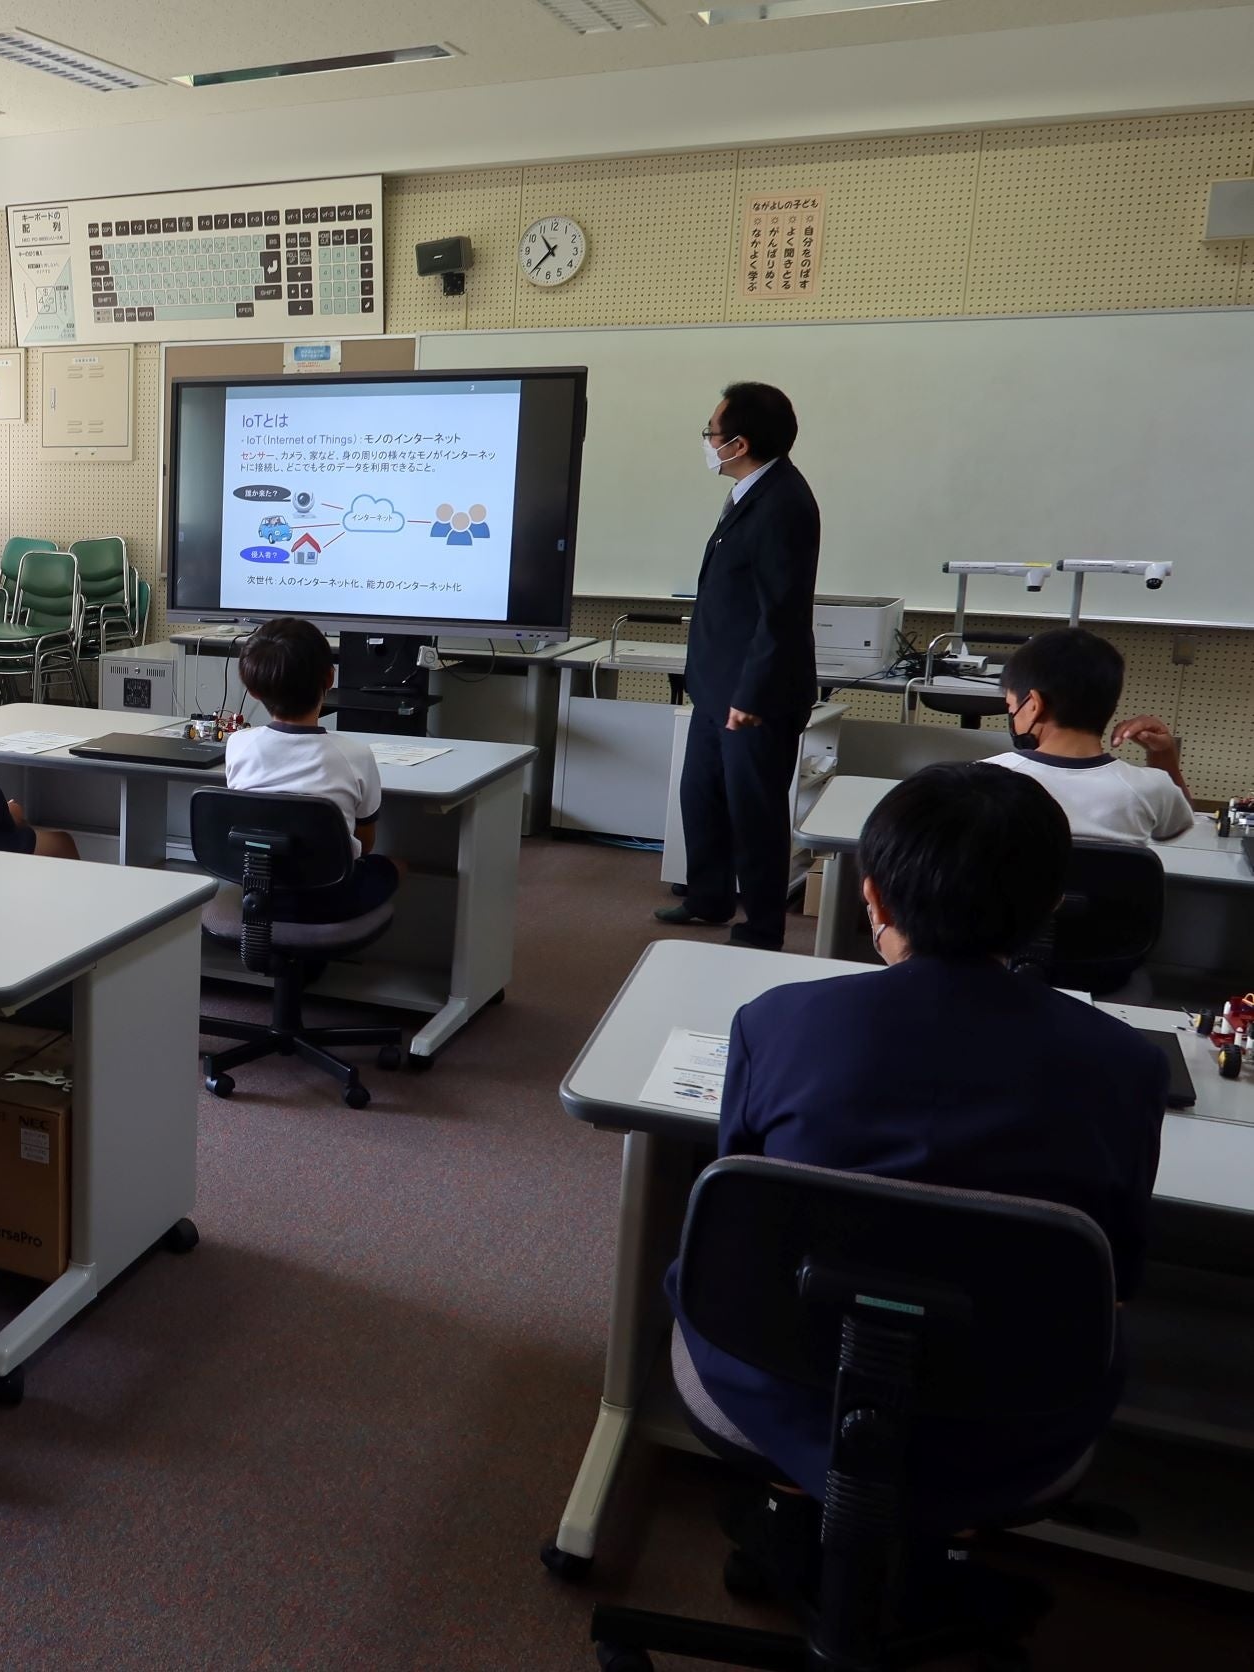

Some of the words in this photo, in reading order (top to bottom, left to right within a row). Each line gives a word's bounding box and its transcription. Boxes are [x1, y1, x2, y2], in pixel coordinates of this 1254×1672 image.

[540, 225, 546, 234] 11
[551, 221, 559, 231] 12
[564, 225, 568, 234] 1
[529, 233, 537, 243] 10
[571, 234, 577, 243] 2
[524, 246, 530, 255] 9
[572, 247, 578, 256] 3
[747, 228, 761, 292] なかよく学ぶ
[765, 226, 779, 290] がんばりぬく
[799, 226, 814, 289] 自分をのばす
[526, 259, 532, 267] 8
[567, 259, 573, 268] 4
[535, 267, 541, 276] 7
[546, 271, 551, 280] 6
[556, 267, 562, 277] 5
[242, 413, 289, 428] IoTとは
[306, 435, 317, 444] of
[351, 513, 393, 522] インターネット
[19, 1115, 50, 1131] NEC
